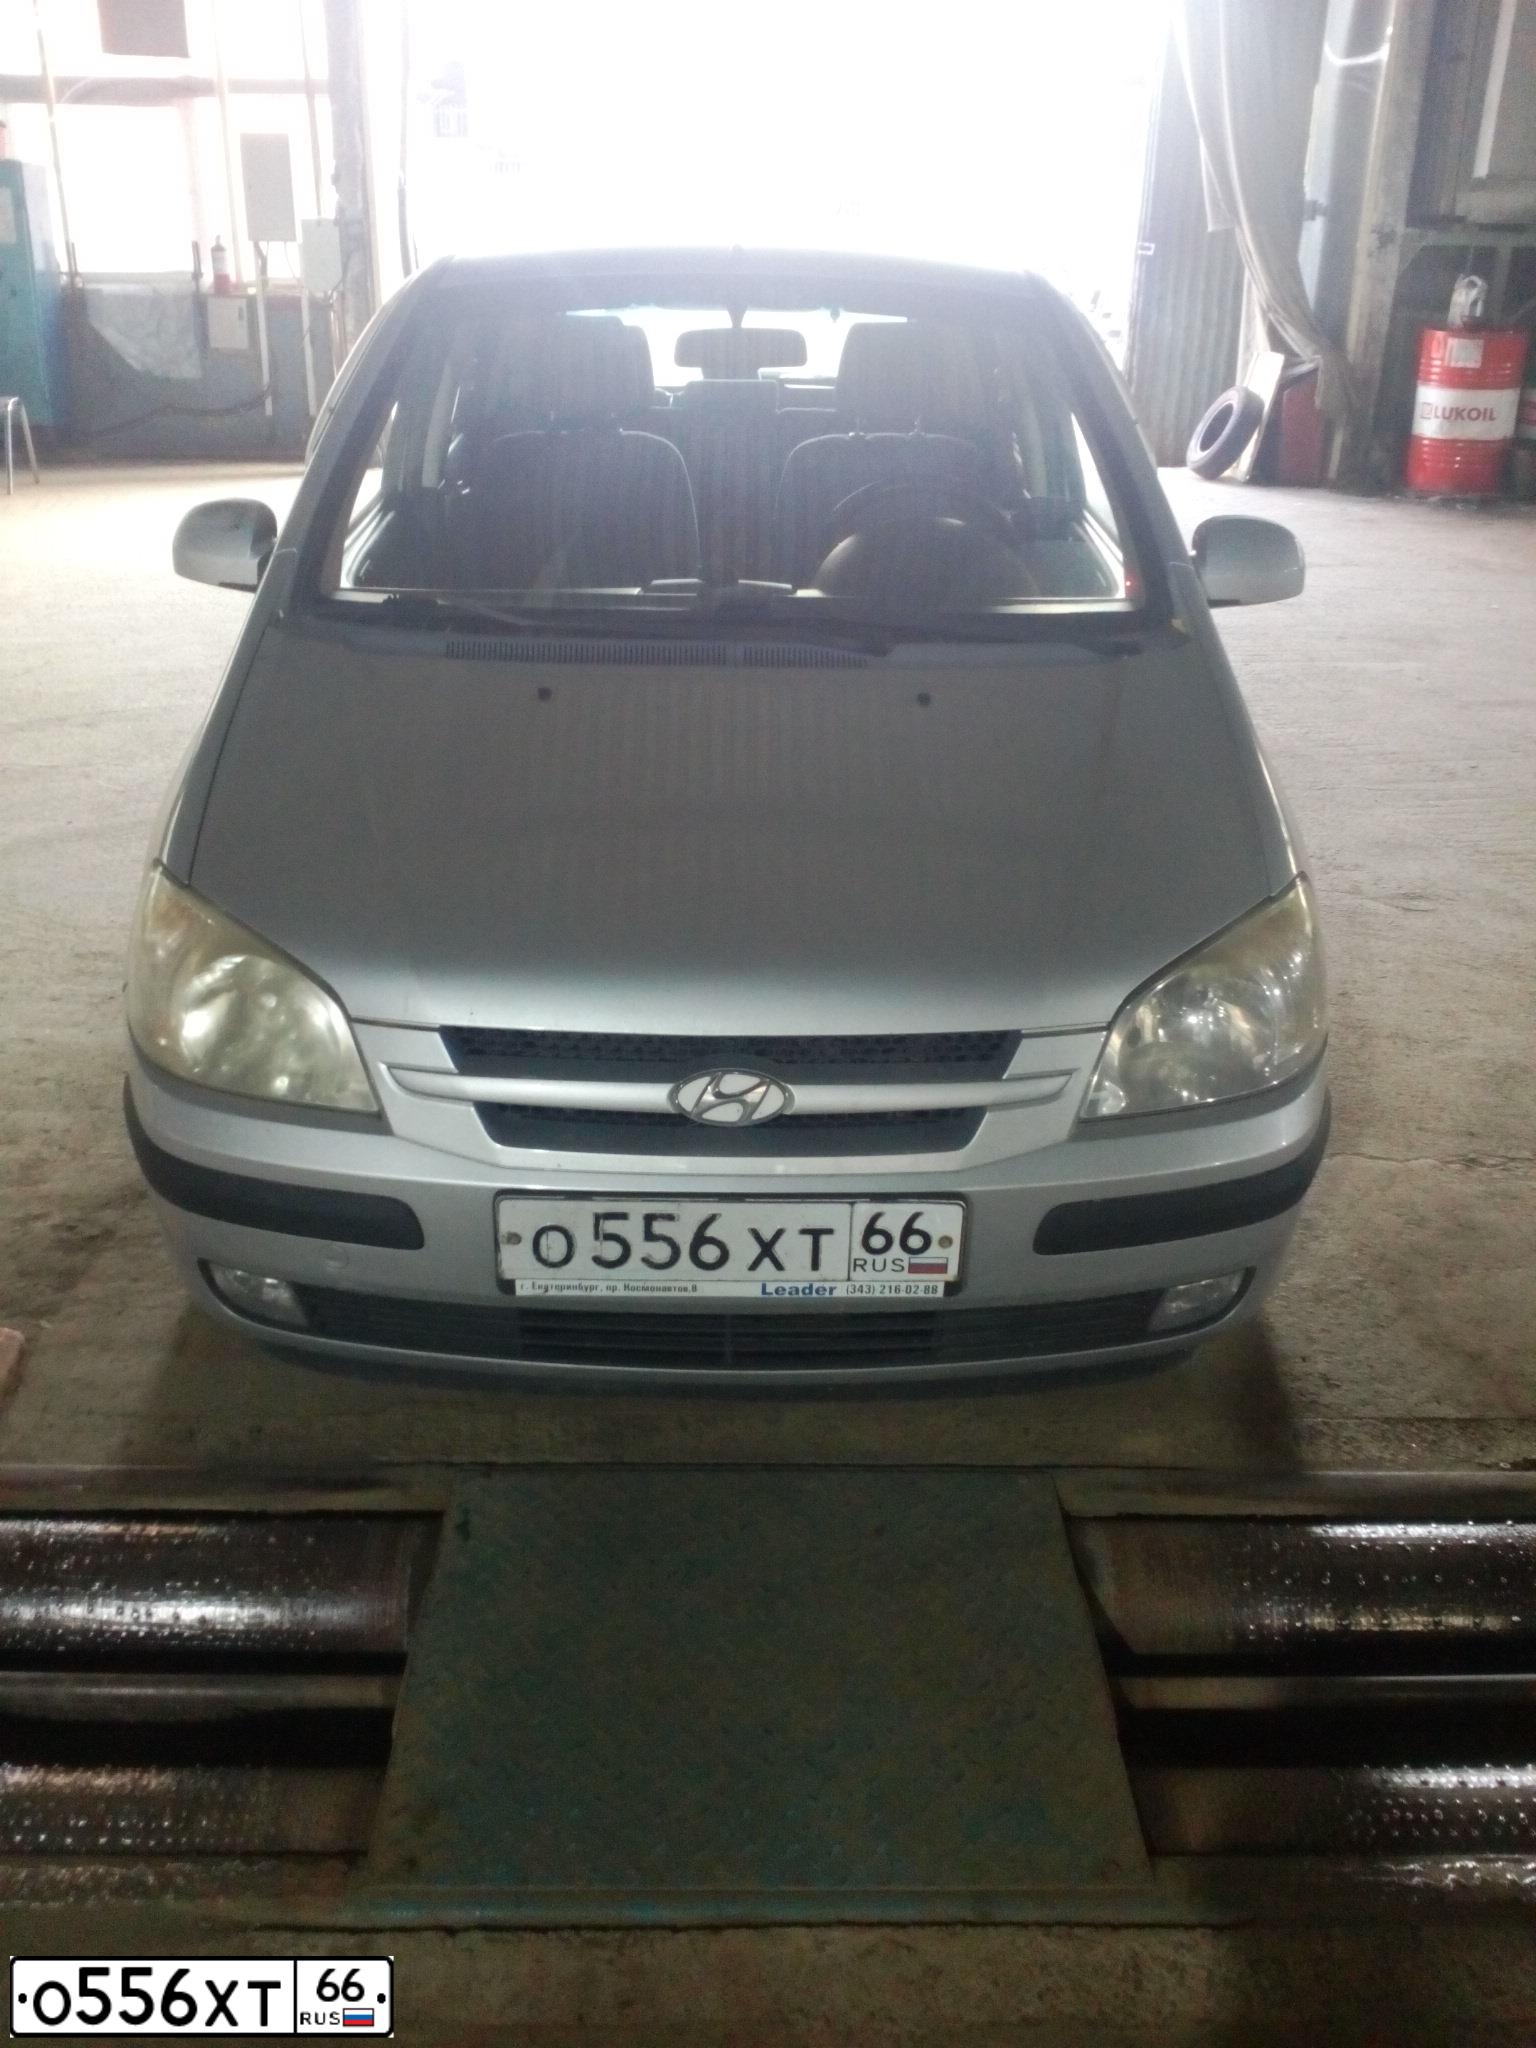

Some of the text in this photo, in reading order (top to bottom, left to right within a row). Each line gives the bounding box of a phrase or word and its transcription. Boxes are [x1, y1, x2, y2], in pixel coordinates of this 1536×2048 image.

[1434, 405, 1497, 421] LUKOIL
[861, 1212, 932, 1256] 66
[852, 1257, 905, 1273] RUS
[761, 1282, 837, 1296] Leader
[846, 1283, 875, 1296] (343)
